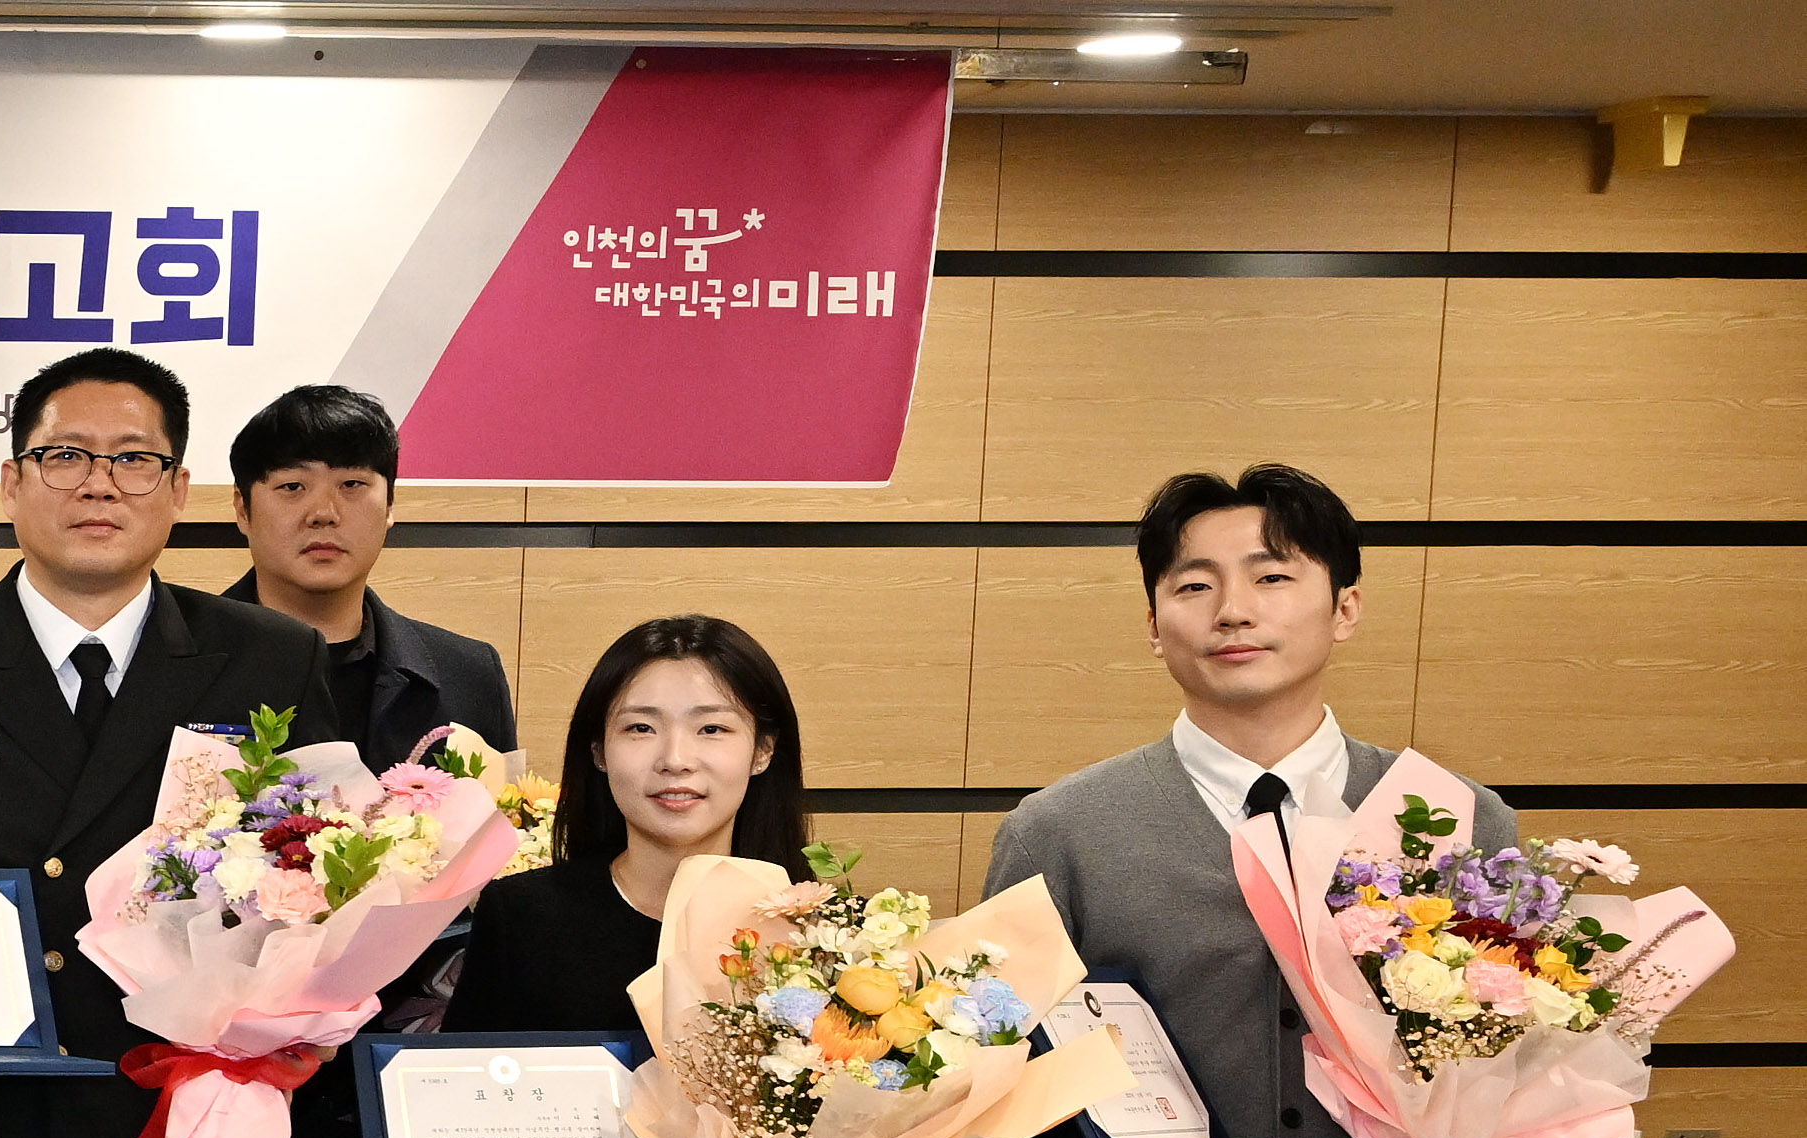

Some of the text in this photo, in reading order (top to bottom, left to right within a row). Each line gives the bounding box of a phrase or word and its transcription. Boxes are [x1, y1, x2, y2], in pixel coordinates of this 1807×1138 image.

[563, 207, 743, 273] 인천의 꿈
[594, 270, 897, 320] 대한민국의 미래
